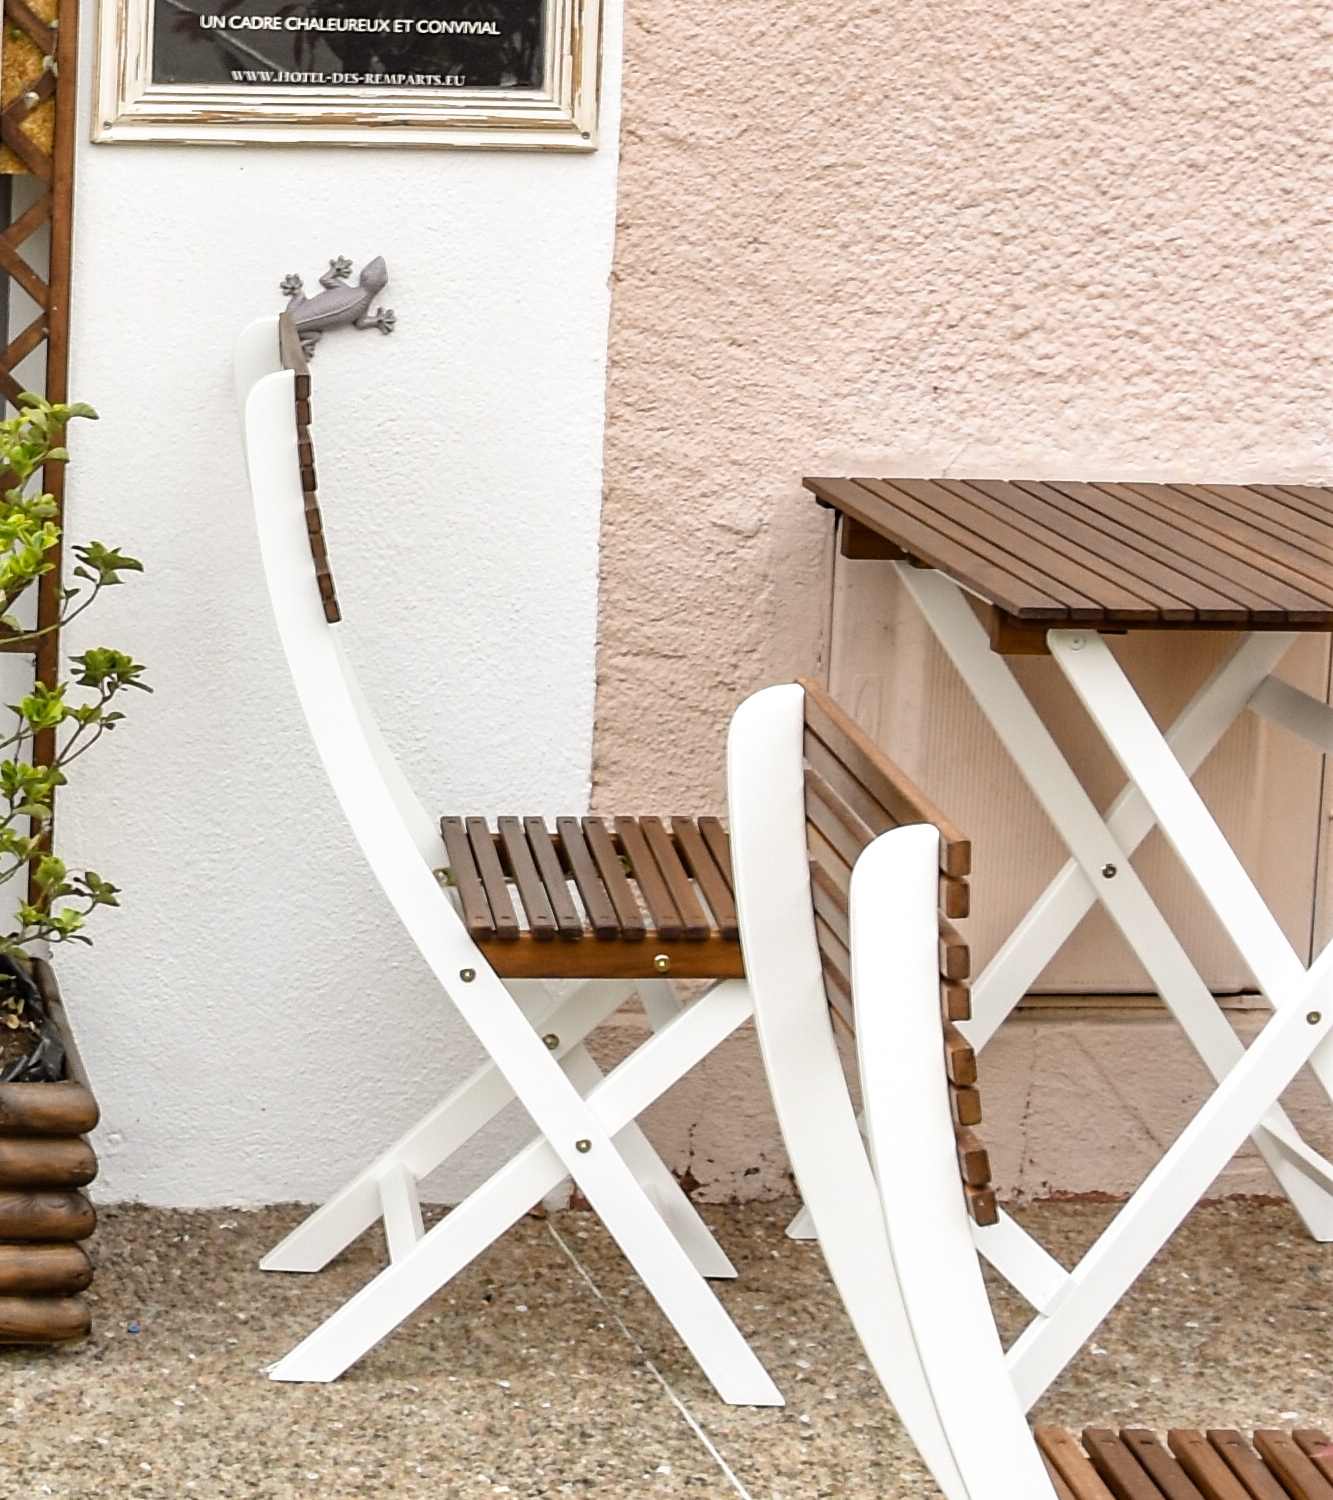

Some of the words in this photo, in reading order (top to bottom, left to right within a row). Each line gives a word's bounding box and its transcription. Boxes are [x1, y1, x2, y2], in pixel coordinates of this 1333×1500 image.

[199, 14, 226, 30] UN
[227, 15, 283, 31] CADRE
[283, 16, 391, 34] CHALEUREUX
[393, 20, 415, 33] ET
[416, 20, 502, 36] CONVIVIAL
